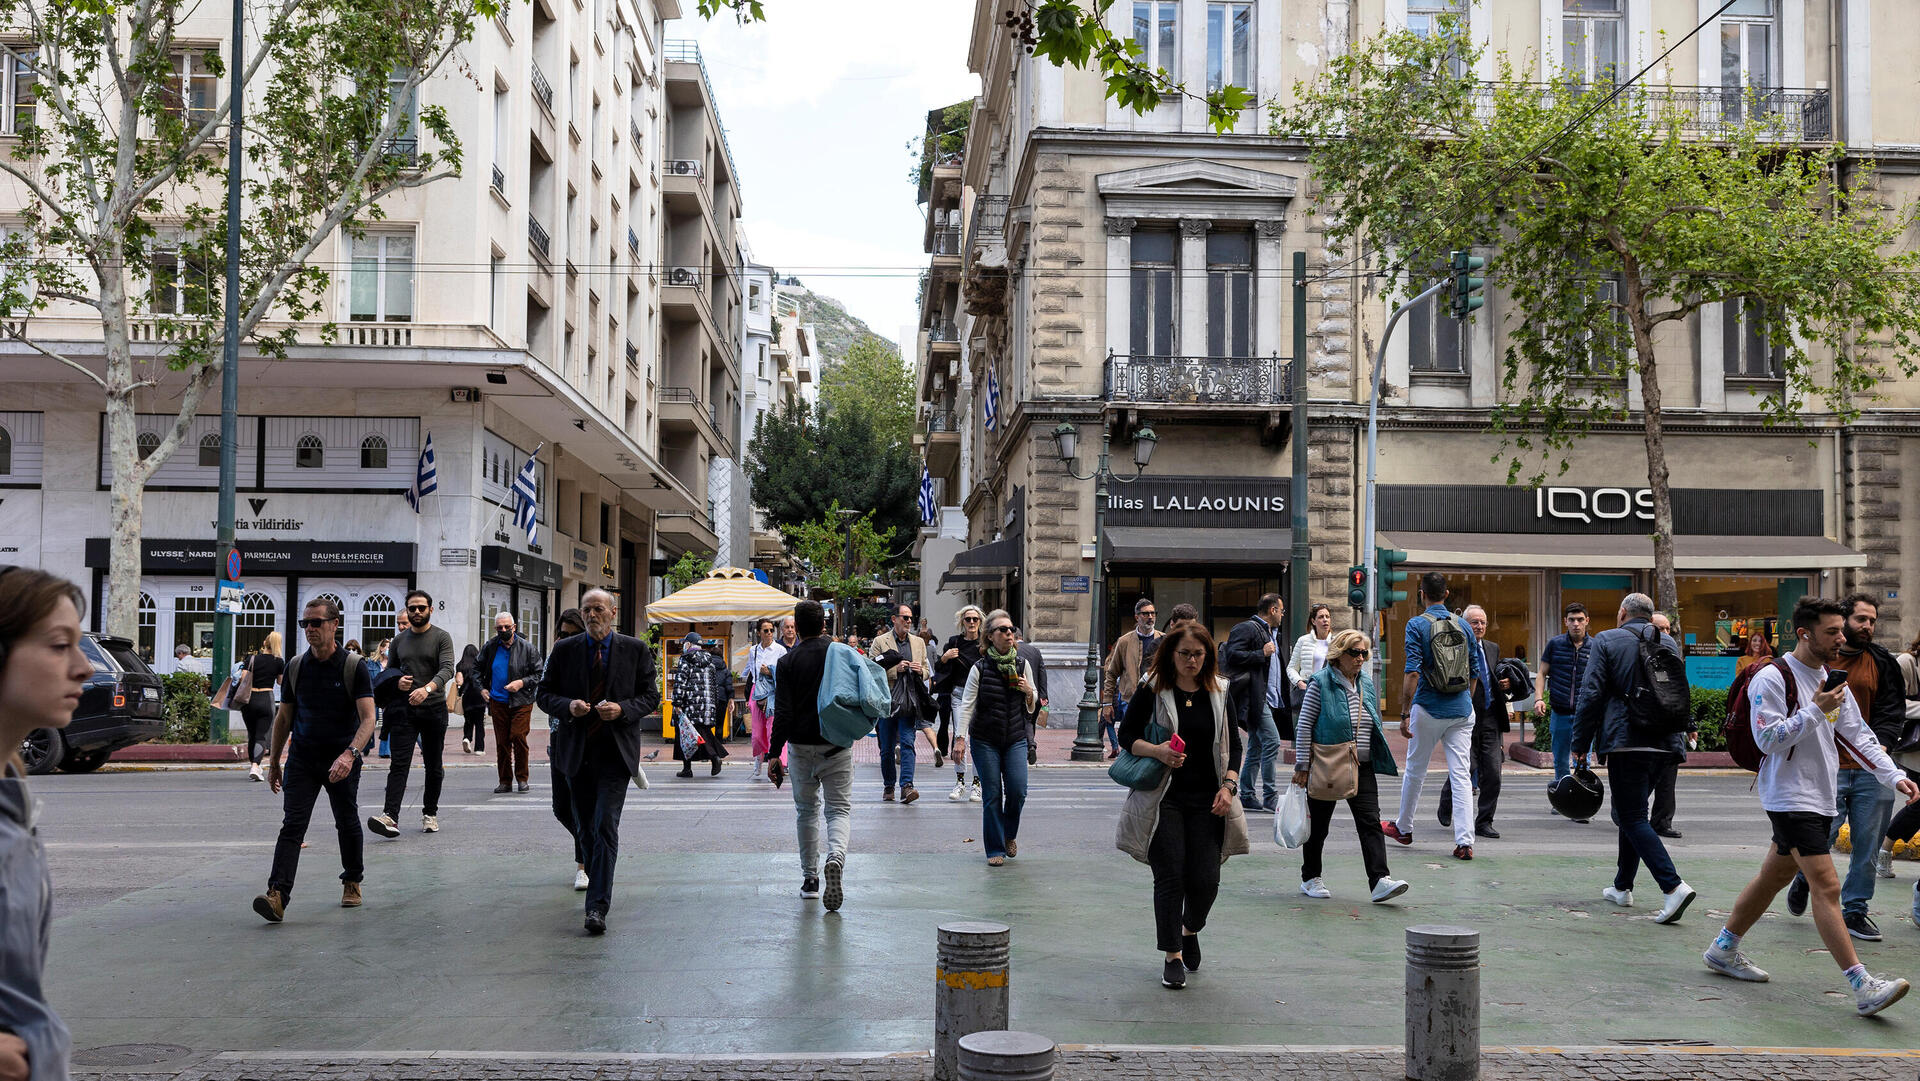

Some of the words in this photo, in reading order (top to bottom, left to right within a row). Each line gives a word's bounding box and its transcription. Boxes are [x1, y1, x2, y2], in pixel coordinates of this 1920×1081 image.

[1108, 494, 1144, 510] ilias
[1536, 487, 1656, 524] IQOS
[252, 518, 301, 531] vildiridis
[150, 550, 184, 558] ULYSSE
[188, 551, 217, 559] NARDI
[244, 552, 291, 560] PARMIGIANI
[438, 600, 446, 611] 8
